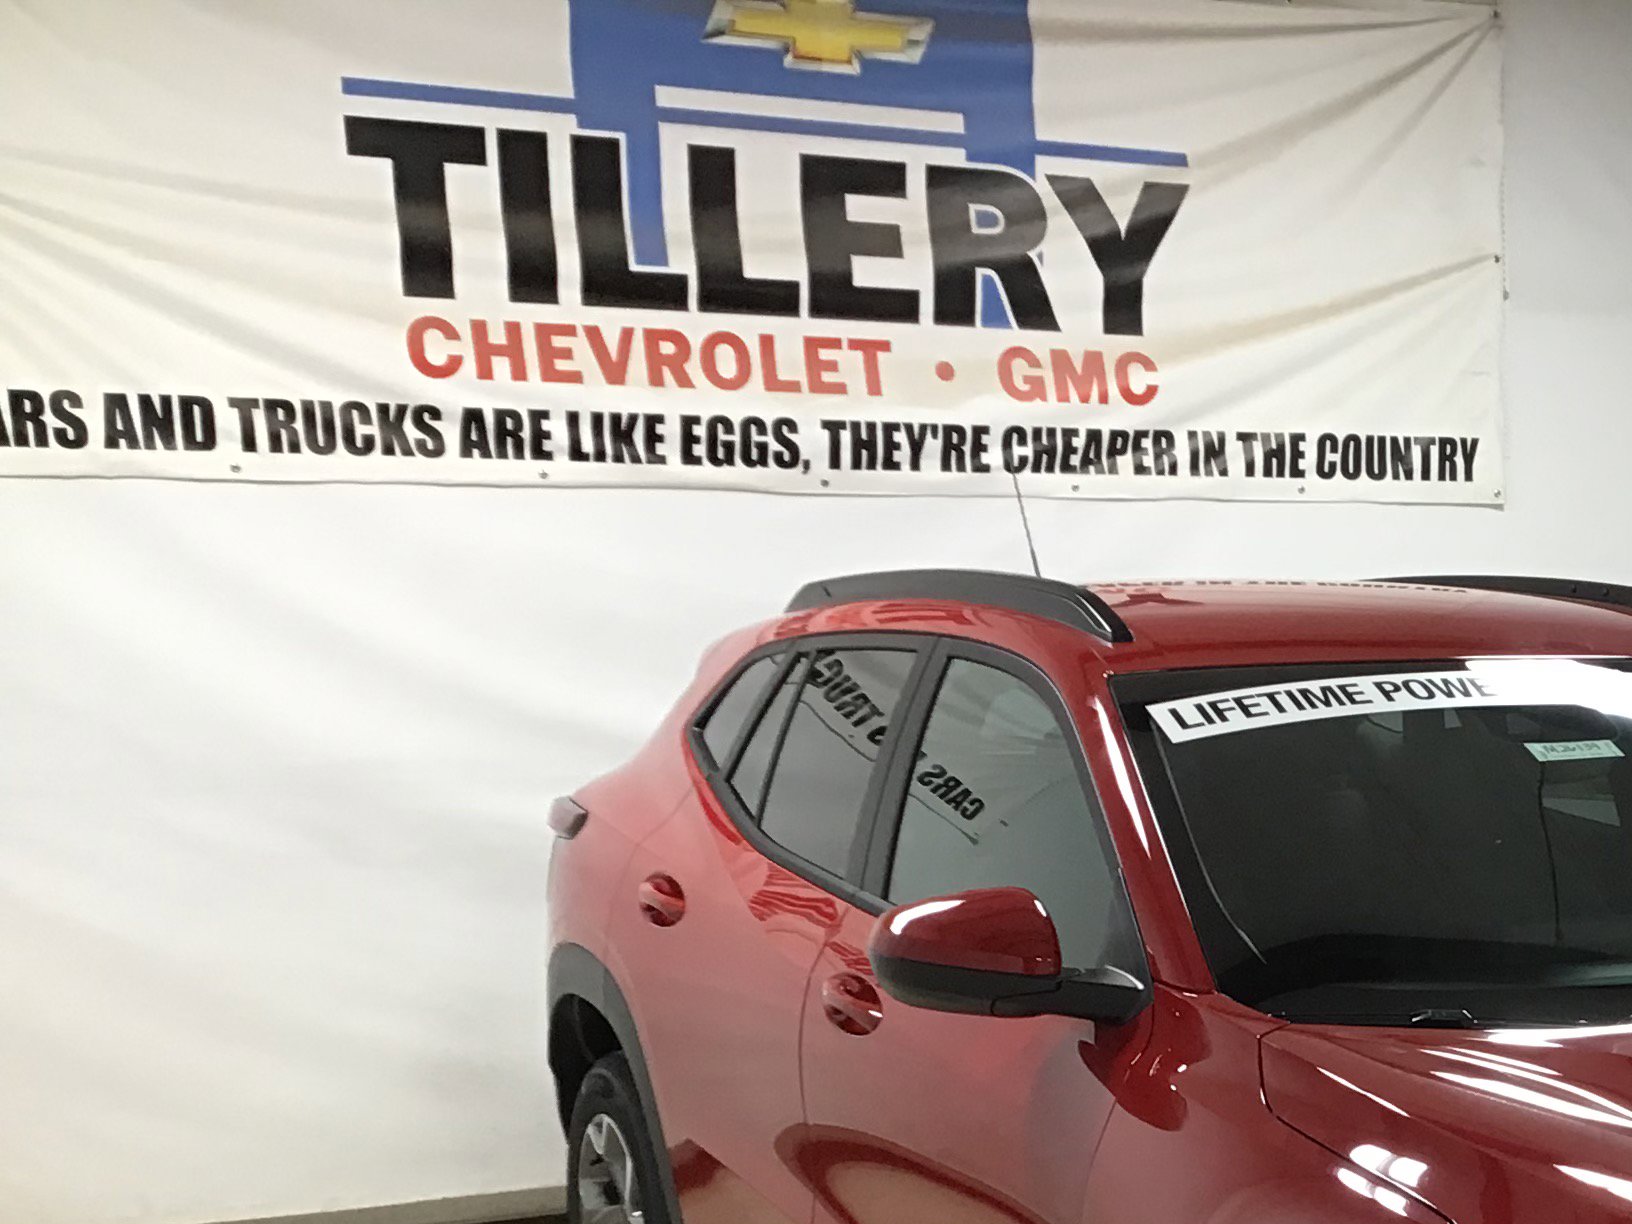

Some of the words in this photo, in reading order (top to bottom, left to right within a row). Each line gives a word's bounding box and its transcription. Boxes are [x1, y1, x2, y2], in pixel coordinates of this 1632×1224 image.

[343, 115, 1189, 336] TILLERY
[406, 315, 892, 396] CHEVROLET
[996, 345, 1159, 406] GMC
[0, 388, 89, 450] RS
[103, 392, 217, 451] AND
[226, 396, 446, 458] TRUCKS
[459, 407, 554, 461] ARE
[565, 410, 667, 465] LIKE
[680, 414, 812, 474] EGGS,
[820, 418, 991, 473] THEY'RE
[1001, 425, 1178, 477] CHEAPER
[1187, 429, 1229, 477] IN
[1236, 432, 1307, 479] THE
[1316, 432, 1479, 482] COUNTRY
[1167, 682, 1374, 732] LIFETIME
[1371, 676, 1500, 704] POWE
